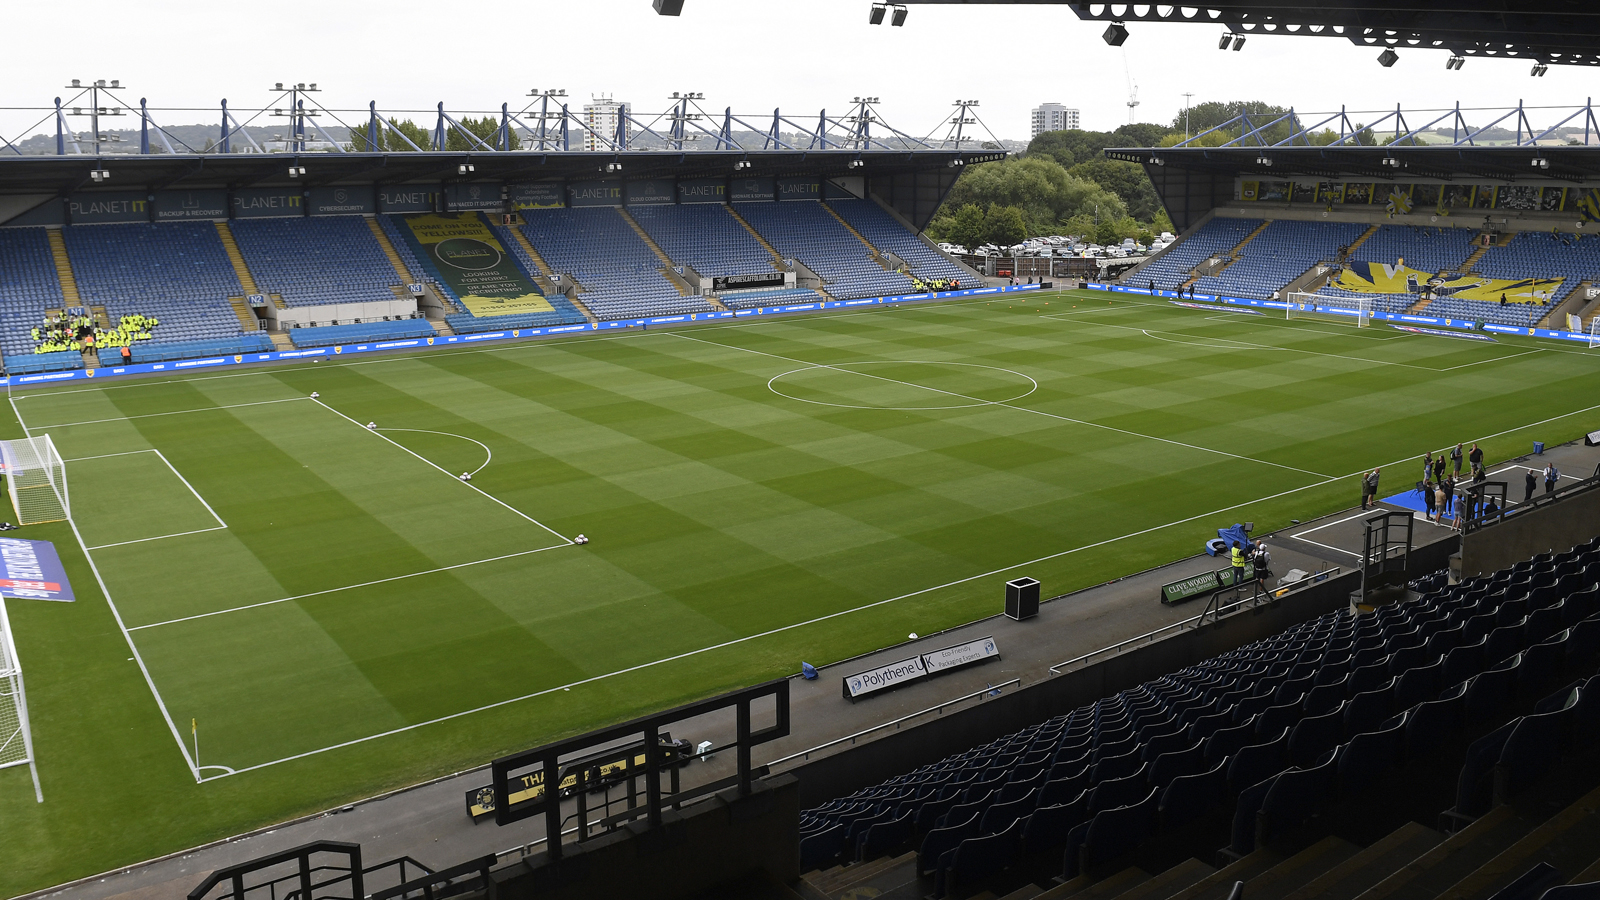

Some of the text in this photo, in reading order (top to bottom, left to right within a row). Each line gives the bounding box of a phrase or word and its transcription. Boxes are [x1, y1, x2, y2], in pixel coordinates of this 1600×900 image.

[571, 188, 620, 199] PLANET IT
[680, 186, 725, 196] PLANET IT
[779, 184, 819, 193] PLANET IT
[234, 196, 301, 209] PLANET IT
[381, 192, 426, 205] PLANET
[70, 200, 146, 214] PLANET IT
[1168, 572, 1230, 594] CLIVE WOODWARD
[1181, 586, 1197, 595] Building
[1197, 582, 1212, 591] Services
[942, 645, 971, 658] Eco-Friendly
[938, 652, 981, 668] Packaging Experts
[863, 664, 915, 687] Polythene
